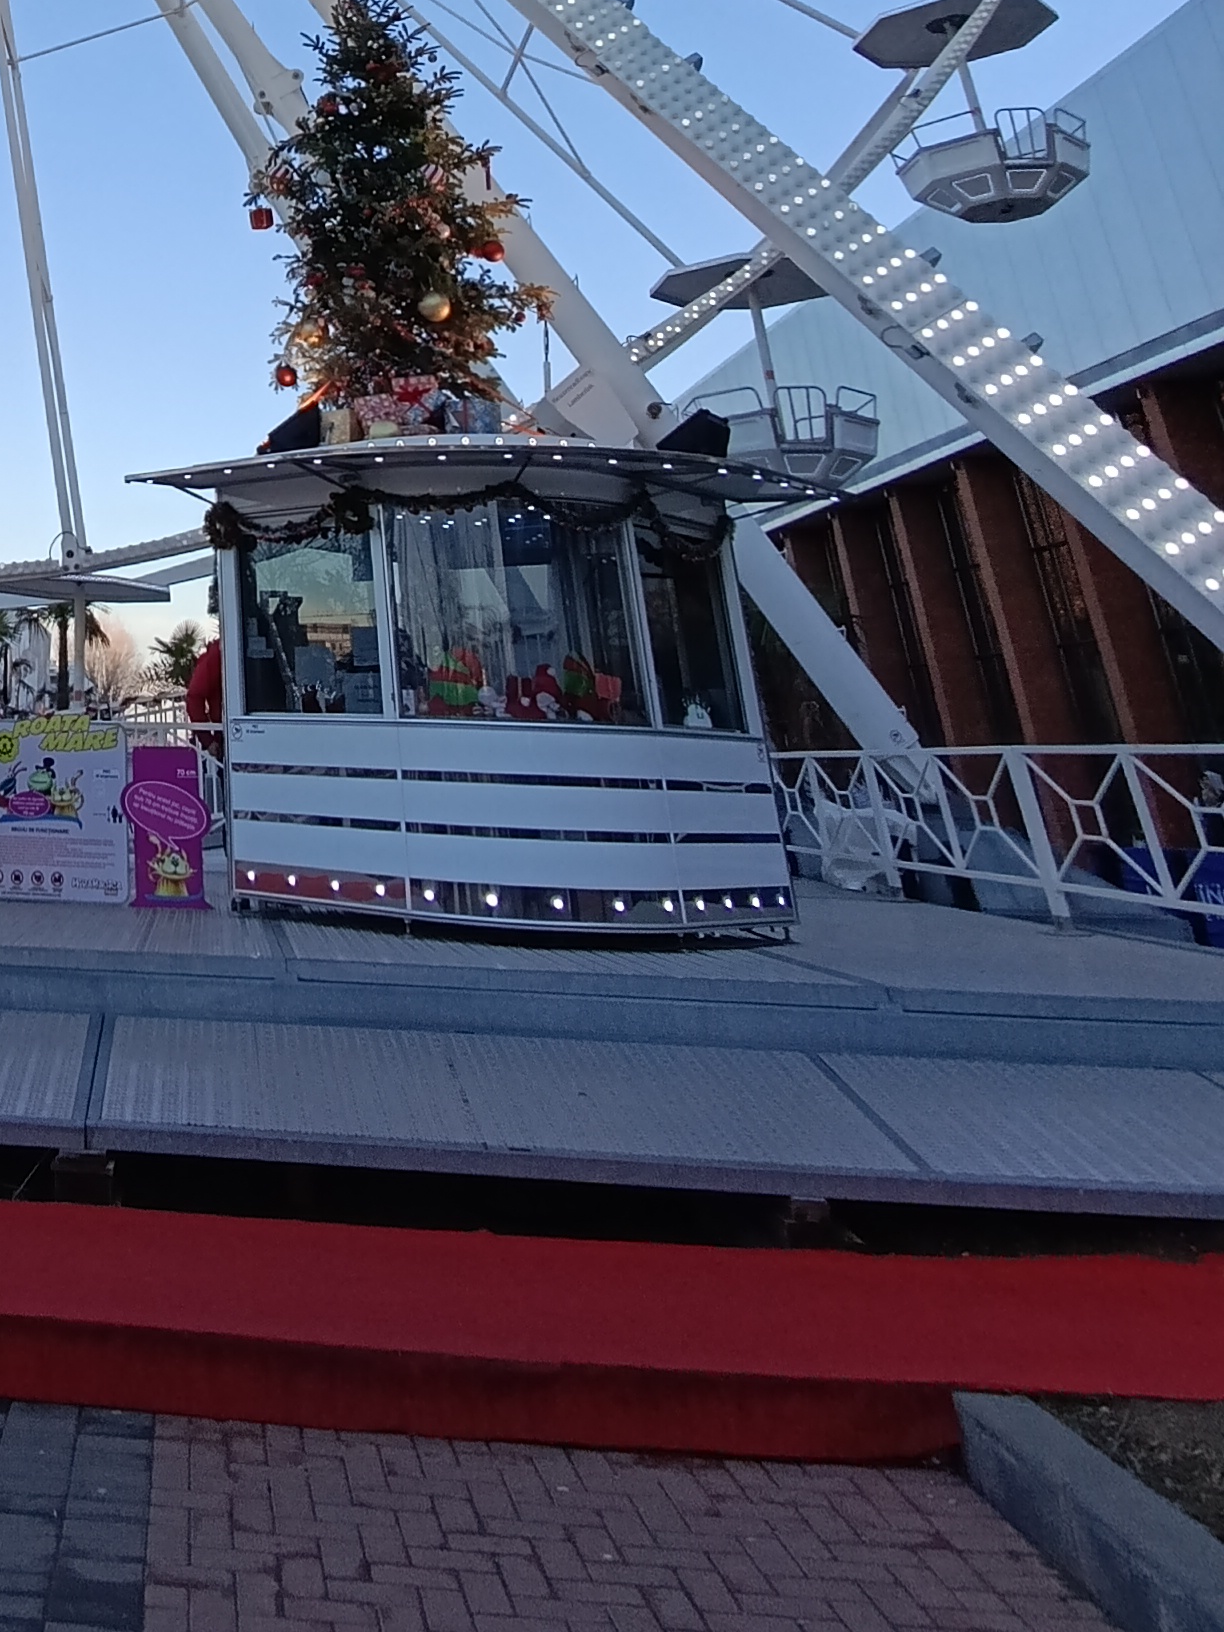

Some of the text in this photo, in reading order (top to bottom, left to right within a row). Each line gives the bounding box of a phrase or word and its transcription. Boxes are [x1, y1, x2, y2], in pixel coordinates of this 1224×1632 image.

[11, 714, 91, 740] ROATA
[38, 726, 119, 753] MARE
[176, 768, 185, 776] 70
